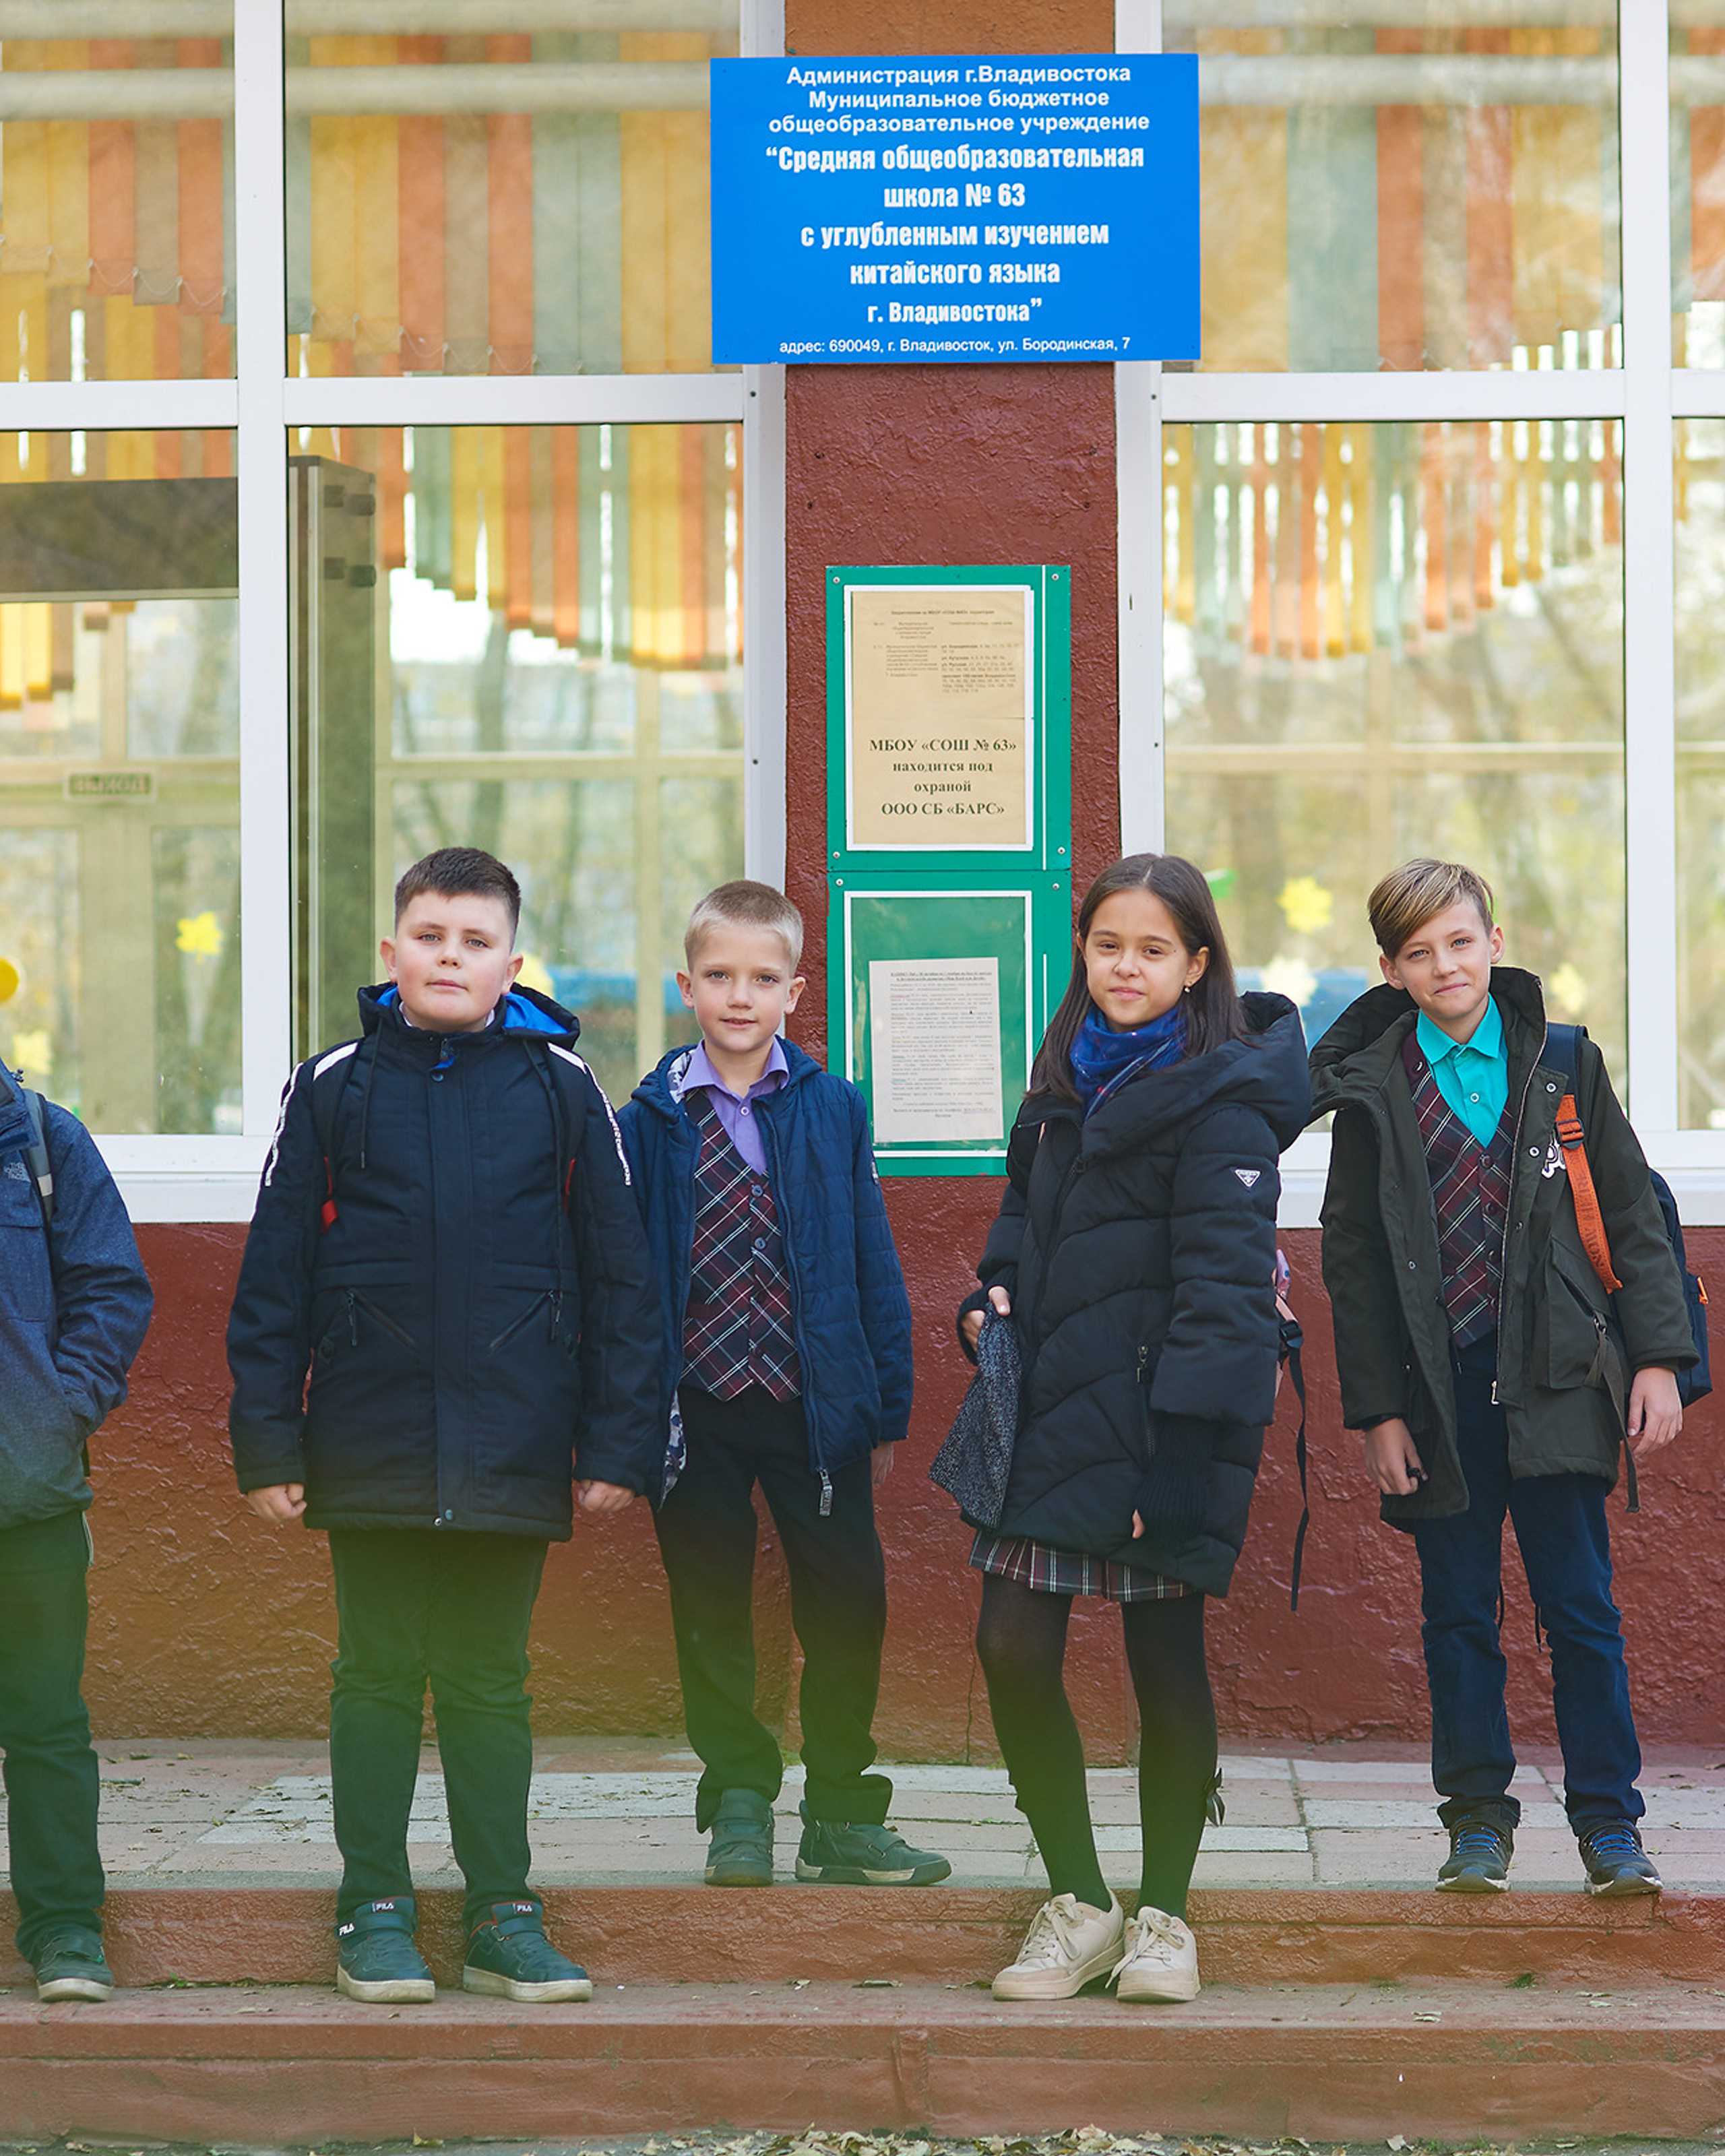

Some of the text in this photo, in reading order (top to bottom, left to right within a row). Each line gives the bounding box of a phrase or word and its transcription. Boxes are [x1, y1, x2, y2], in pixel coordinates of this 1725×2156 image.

[786, 65, 1131, 87] Администрация г.Владивостока
[809, 89, 1109, 112] Муниципальное бюджетное
[769, 114, 1150, 136] общеобразовательное учреждение
[882, 144, 1144, 172] общеобразовательная
[884, 183, 1026, 208] школа № 63
[801, 221, 1109, 249] с углубленным изучением
[850, 260, 1060, 284] китайского языка
[868, 306, 883, 323] г.
[779, 337, 1131, 355] адрес: 690049, г. Владивосток, ул. Бородинская, 7
[870, 738, 1017, 751] МБОУ «СОШ № 63»
[893, 763, 993, 774] находится под
[914, 780, 971, 796] охраной
[881, 802, 1005, 815] ООО СБ «БАРС»
[376, 1902, 395, 1911] FILA
[338, 1922, 355, 1936] FILA
